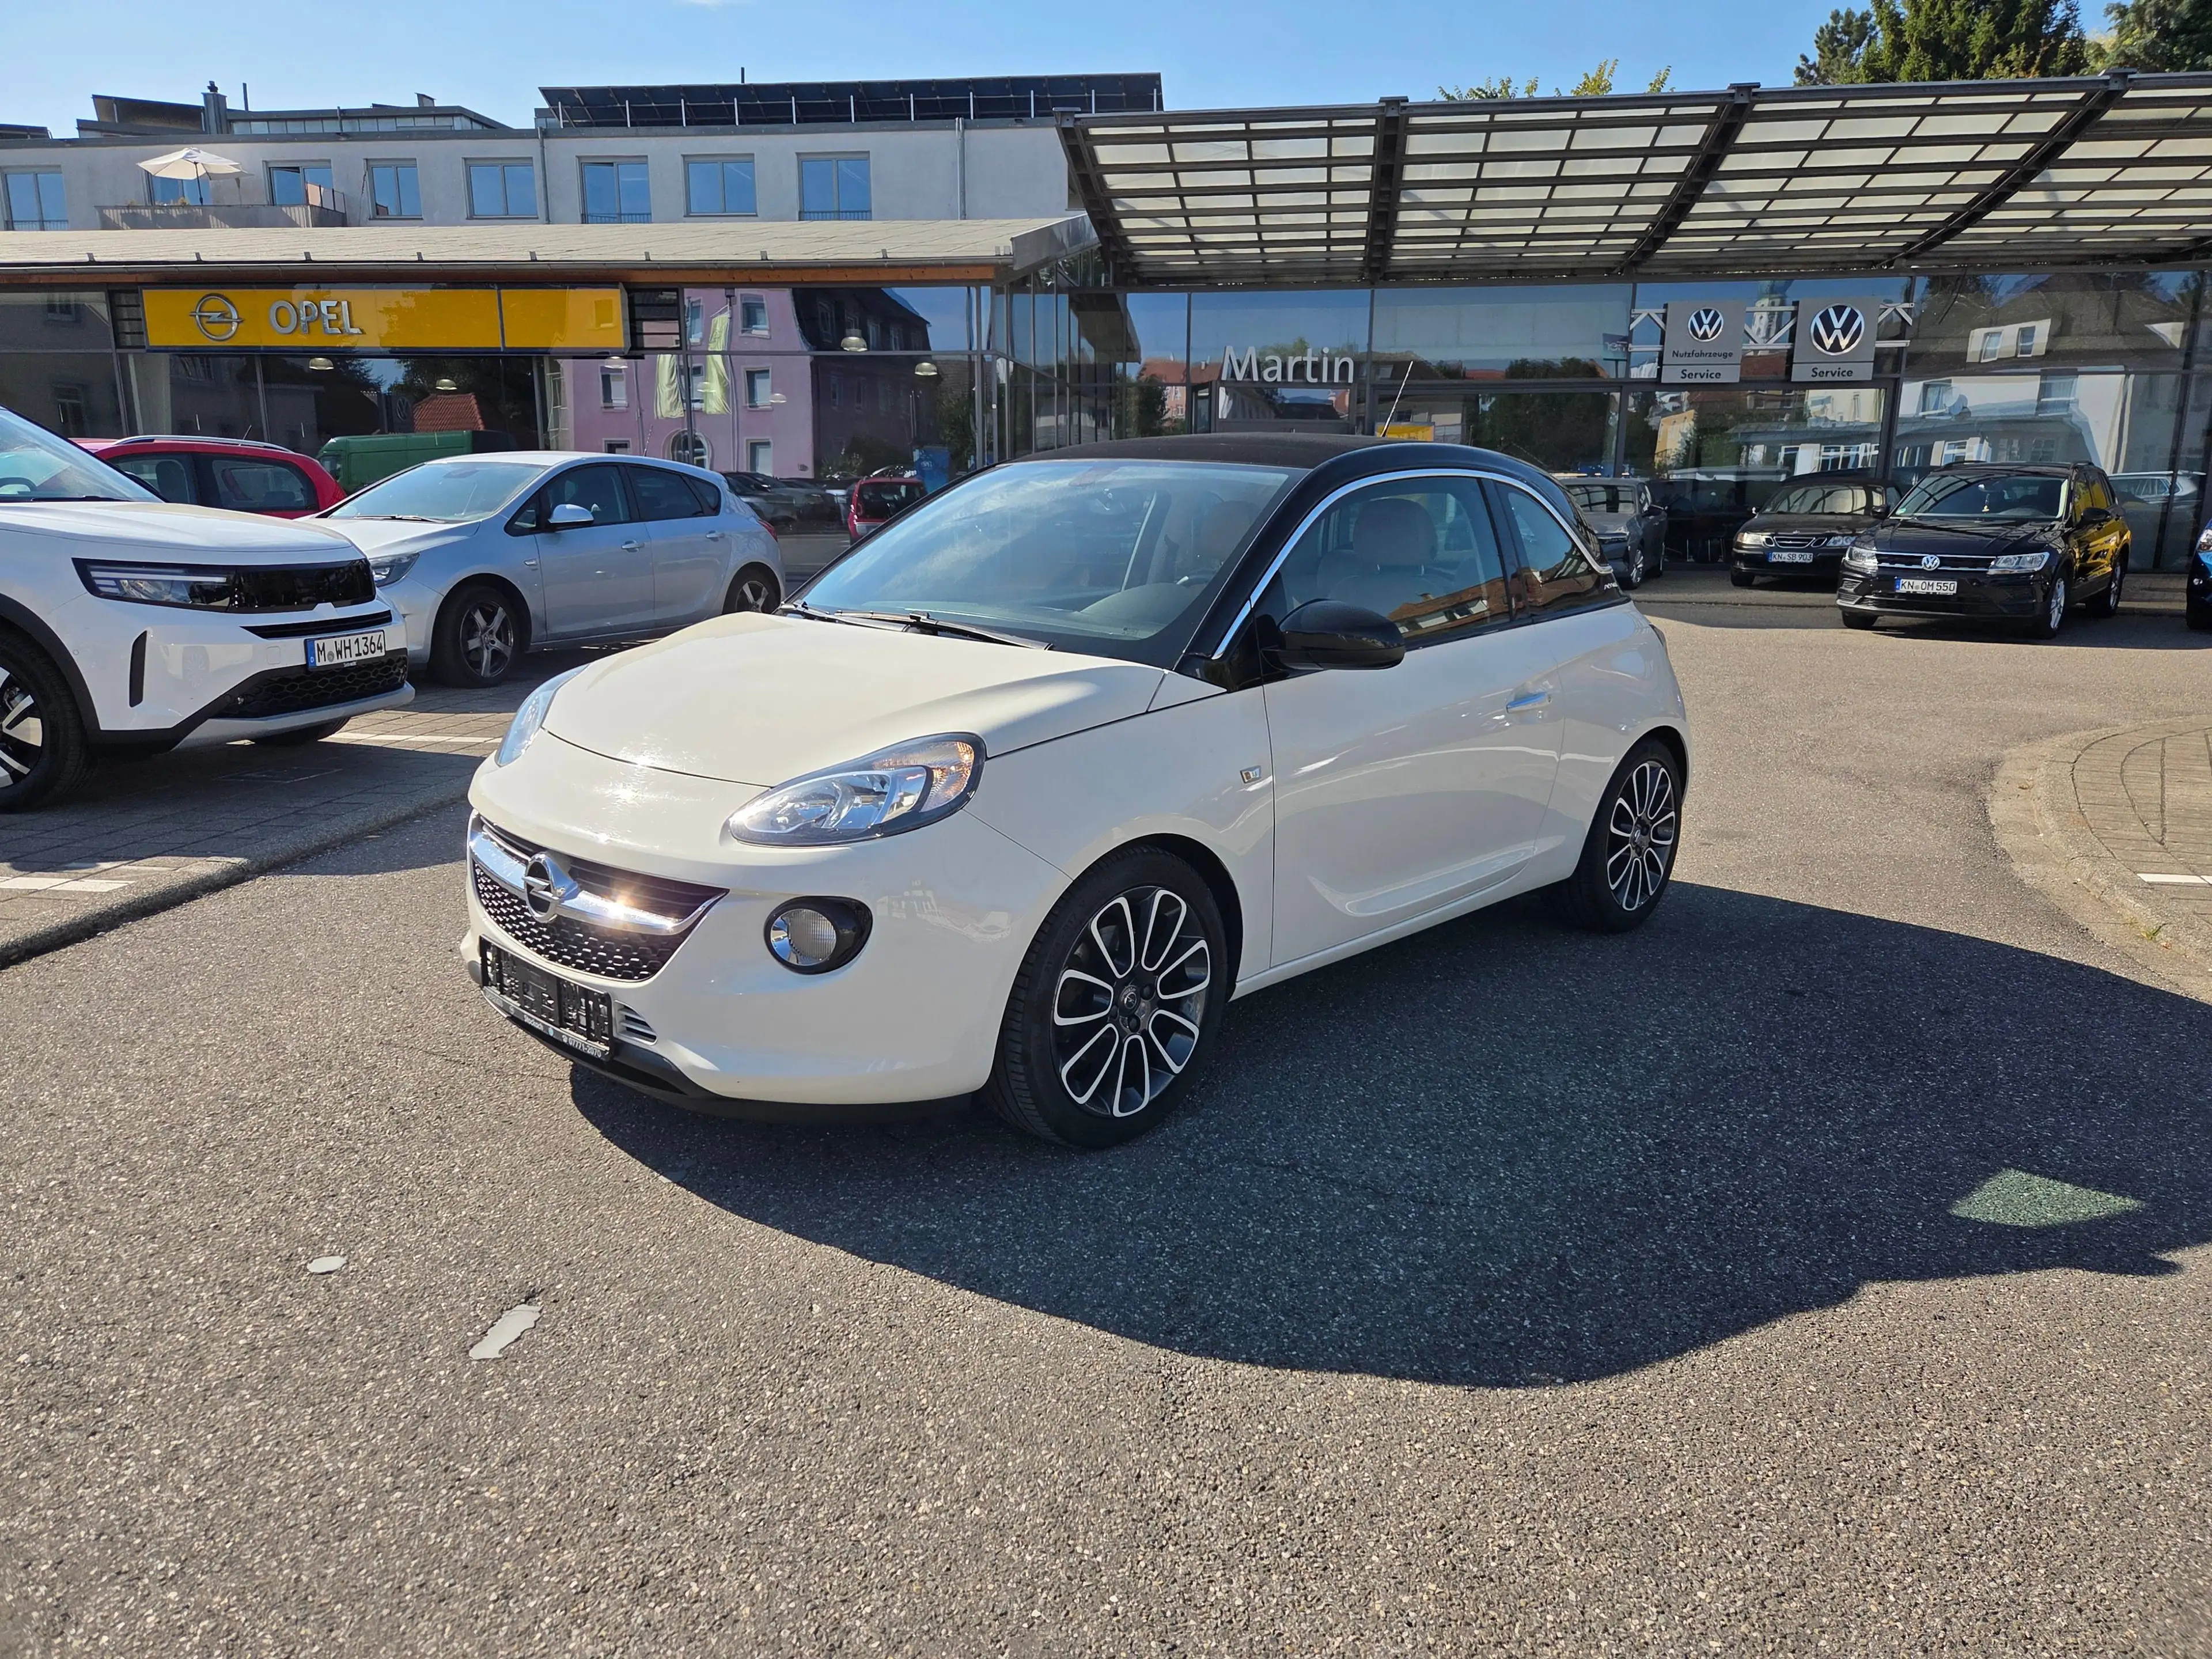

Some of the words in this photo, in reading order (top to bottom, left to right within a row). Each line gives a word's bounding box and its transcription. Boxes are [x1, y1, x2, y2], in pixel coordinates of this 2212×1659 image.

[270, 300, 364, 335] OPEL
[1672, 349, 1733, 358] Nutzfahrzeuge
[1221, 346, 1354, 383] Martin
[1680, 369, 1722, 380] Service
[1811, 367, 1854, 378] Service
[1902, 581, 1914, 589] KN
[1936, 582, 1955, 592] 550
[317, 642, 326, 662] M
[334, 639, 352, 660] WH
[354, 634, 382, 657] 1364
